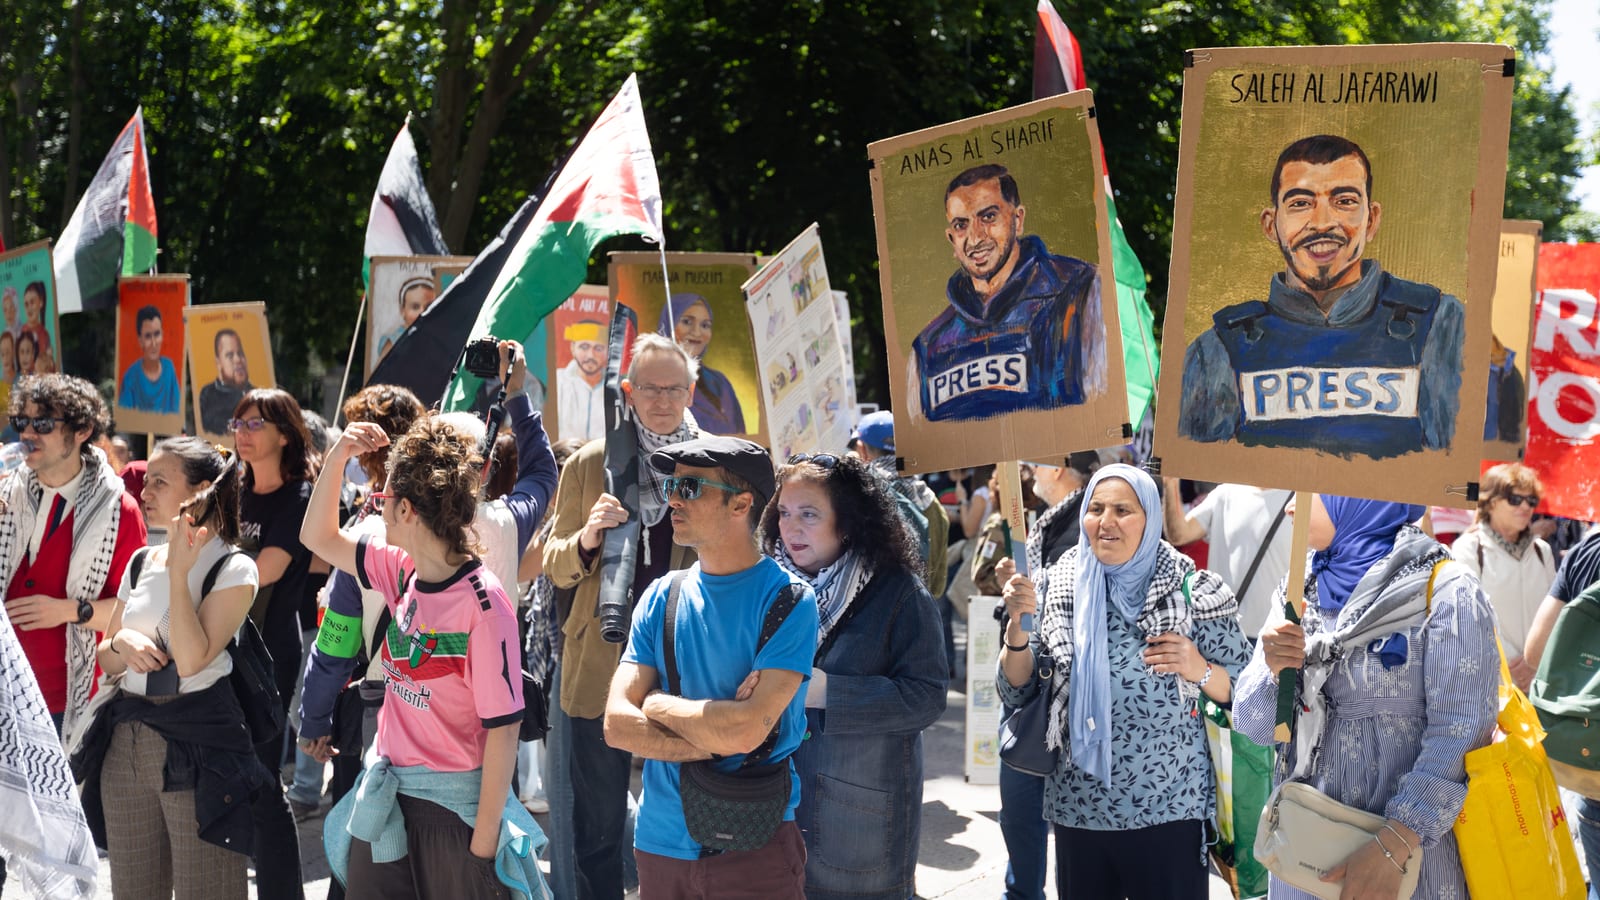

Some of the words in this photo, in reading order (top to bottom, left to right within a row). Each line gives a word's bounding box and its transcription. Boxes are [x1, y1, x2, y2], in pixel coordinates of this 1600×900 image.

[1230, 72, 1295, 104] SALEH
[1303, 72, 1326, 104] AL
[1332, 71, 1438, 104] JAFARAWI
[900, 143, 953, 176] ANAS
[963, 135, 983, 161] AL
[991, 117, 1055, 155] SHARIF
[685, 270, 724, 284] MUSLIM
[934, 357, 1022, 405] PRESS
[1252, 371, 1406, 416] PRESS
[322, 630, 342, 645] ESS
[324, 616, 349, 633] ENSA
